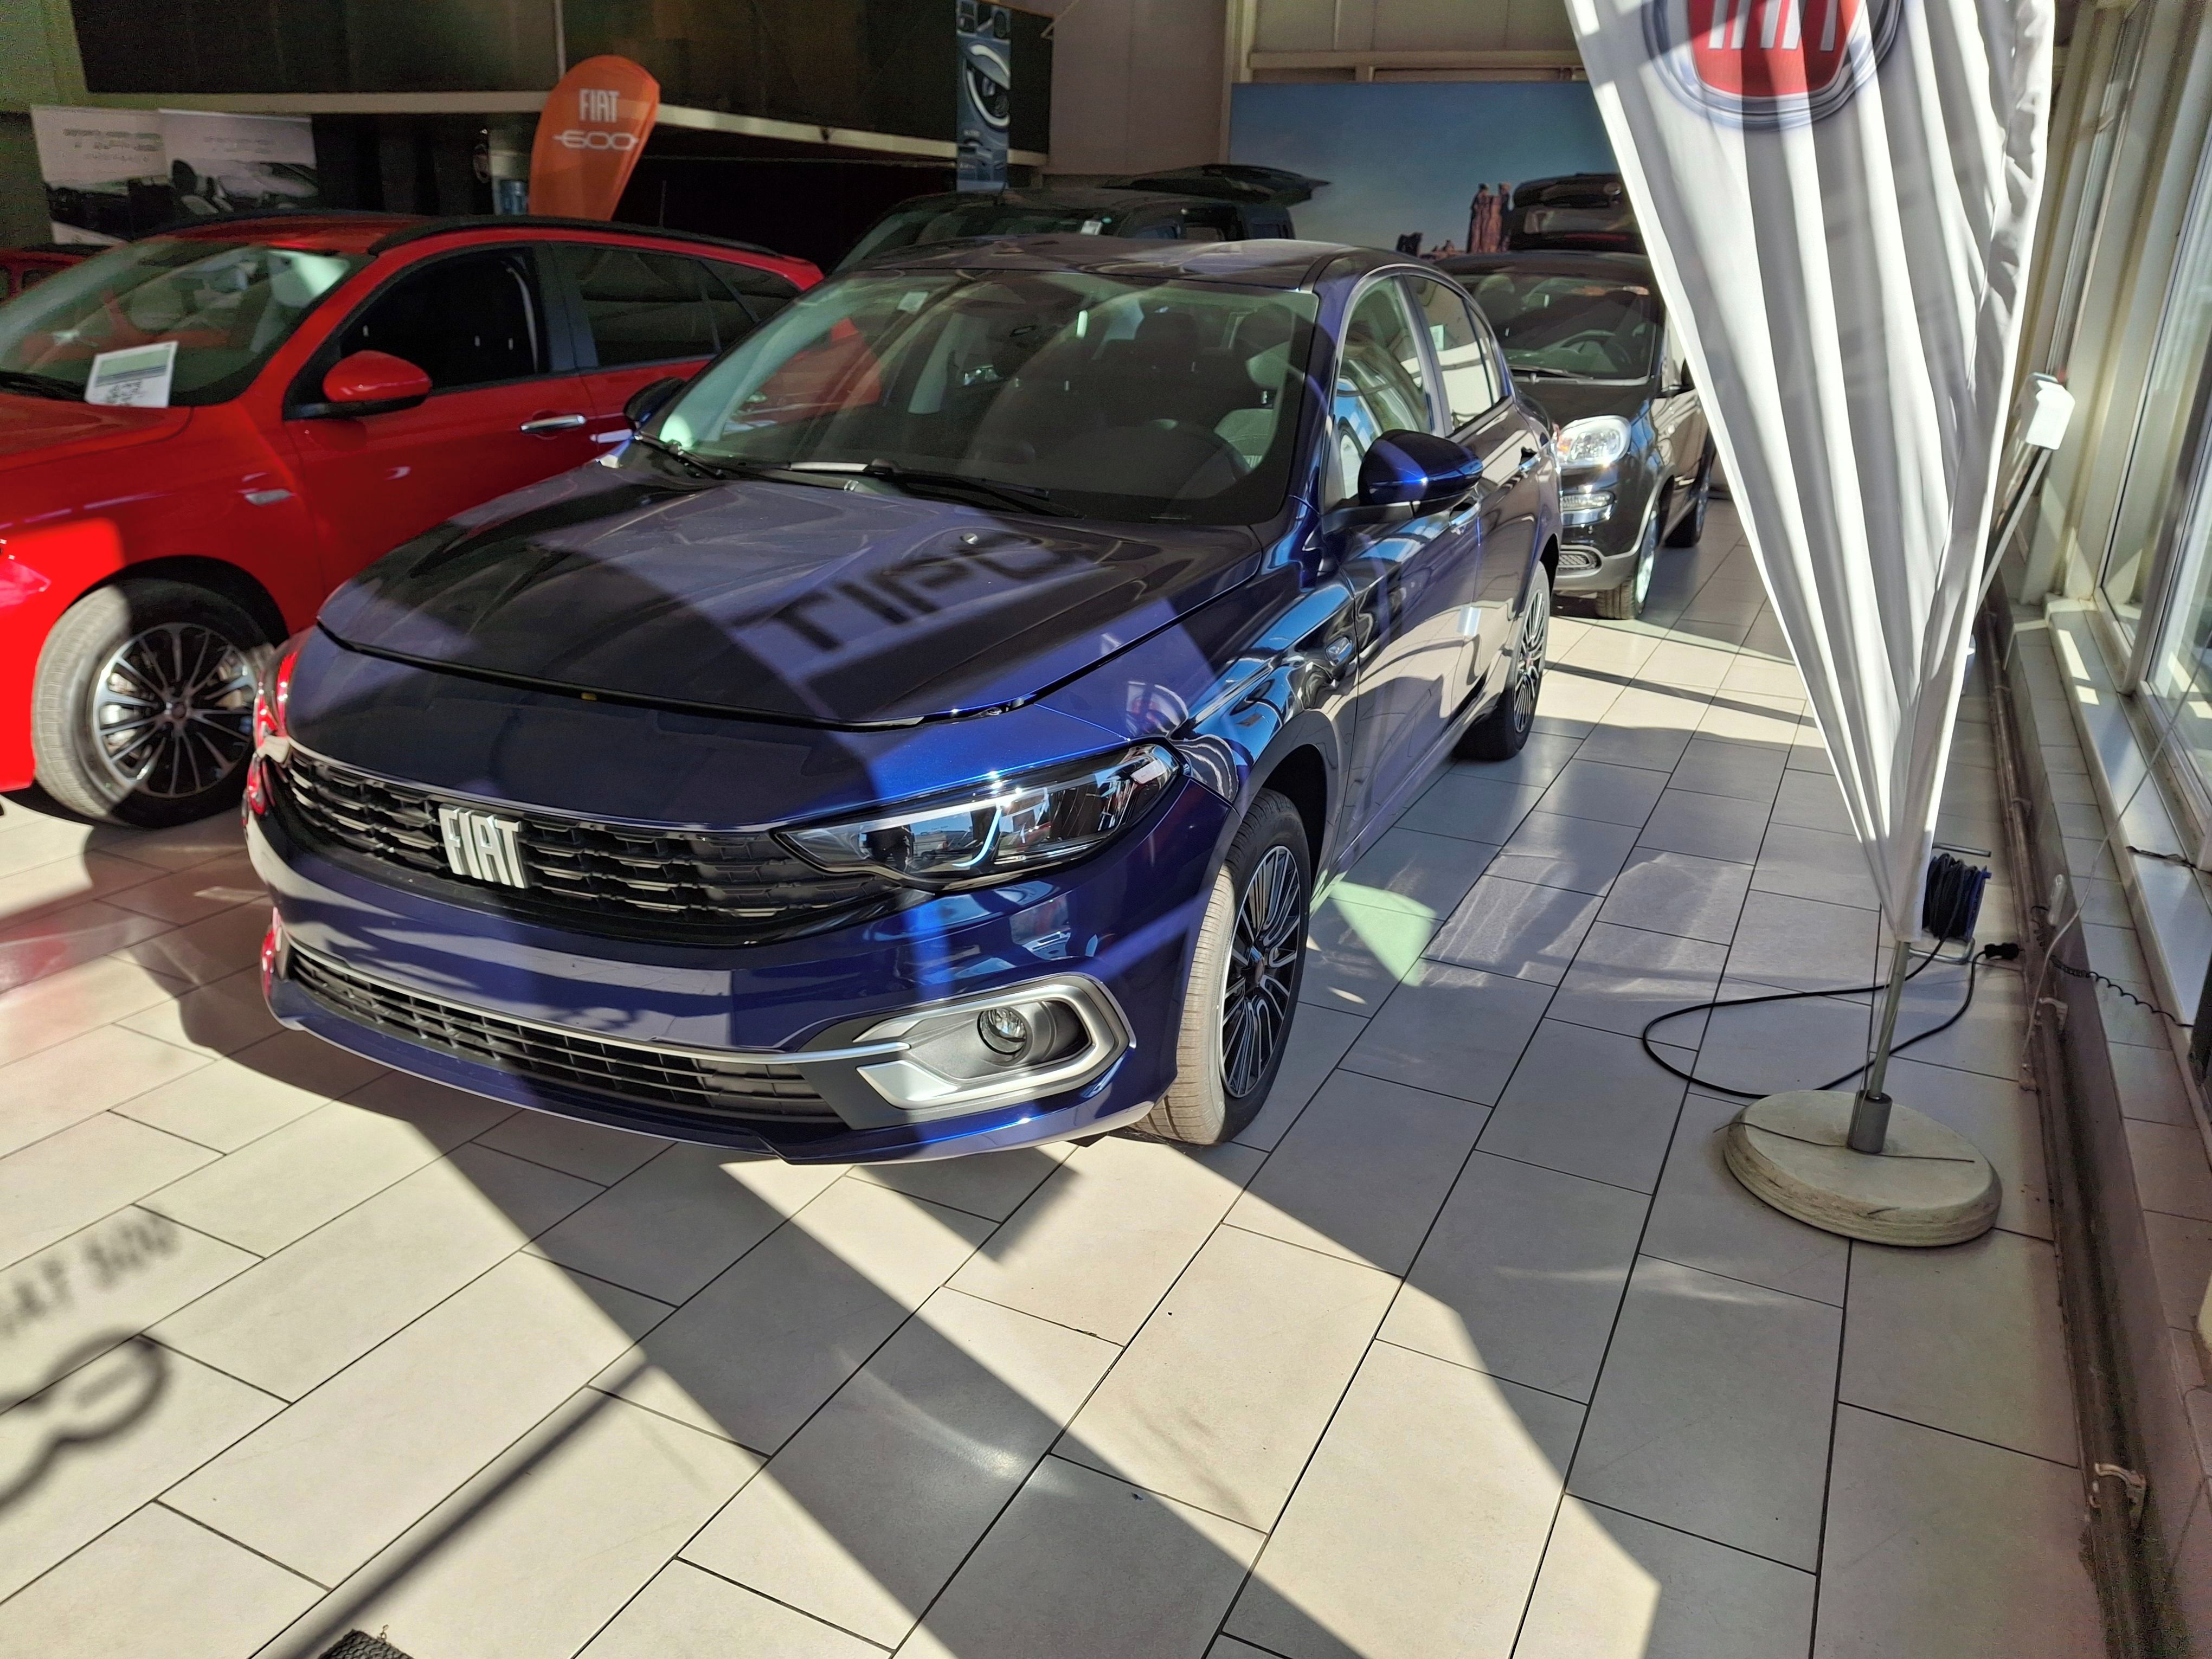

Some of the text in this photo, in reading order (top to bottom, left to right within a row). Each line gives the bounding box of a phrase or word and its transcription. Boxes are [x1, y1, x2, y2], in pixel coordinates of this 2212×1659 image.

[579, 88, 620, 123] FIAT
[554, 130, 638, 151] 600
[438, 803, 529, 889] FIAT
